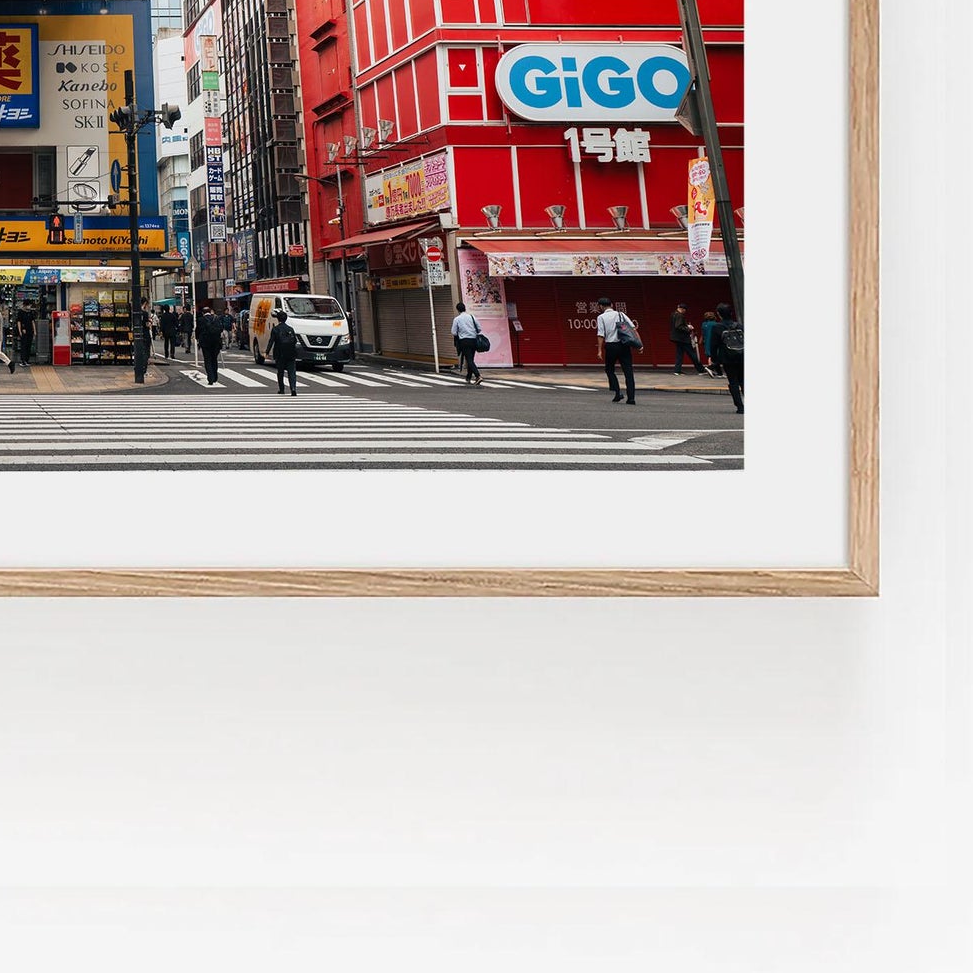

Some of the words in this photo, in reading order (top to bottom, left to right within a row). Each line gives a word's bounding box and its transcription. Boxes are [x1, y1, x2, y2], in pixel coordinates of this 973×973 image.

[47, 43, 125, 55] SHISEIDO
[80, 61, 119, 73] KOSÉ
[58, 79, 117, 92] Kanebo
[509, 55, 692, 110] GiGO
[62, 99, 115, 110] SOFINA
[563, 127, 652, 163] 1号館
[576, 301, 627, 314] 営業間
